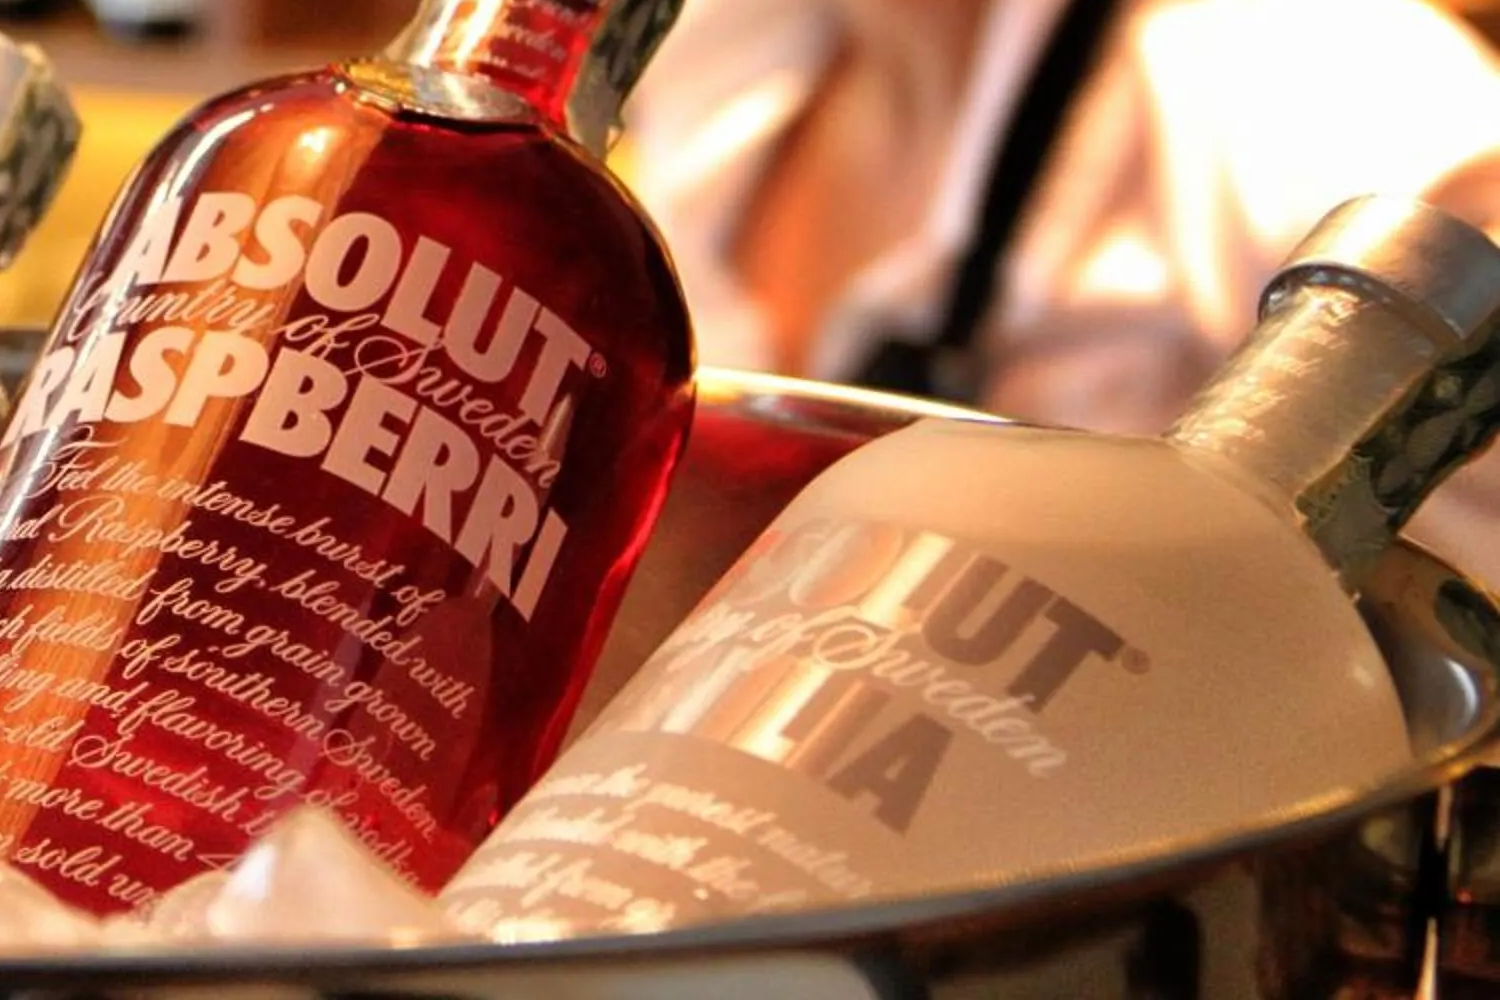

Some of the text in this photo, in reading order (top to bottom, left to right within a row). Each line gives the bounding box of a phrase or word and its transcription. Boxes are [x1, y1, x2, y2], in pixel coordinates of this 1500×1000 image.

[67, 271, 561, 489] Cuntry of Sweden
[97, 191, 592, 428] ABSOLUT
[26, 425, 446, 627] Feel the intense burst of
[7, 553, 157, 601] distilled
[135, 578, 246, 635] from
[207, 624, 348, 688] grain
[323, 680, 437, 761] grown
[11, 604, 123, 656] fields
[115, 634, 182, 680] of
[160, 648, 326, 743] southern
[48, 495, 268, 593] Raspberry,
[269, 570, 422, 666] blended
[405, 654, 475, 719] with
[46, 682, 148, 714] and
[117, 690, 306, 801] flavoring
[66, 734, 249, 823] Swedish
[812, 620, 1069, 779] Sweden
[4, 775, 104, 821] more
[99, 802, 195, 862] than
[14, 838, 104, 887] sold
